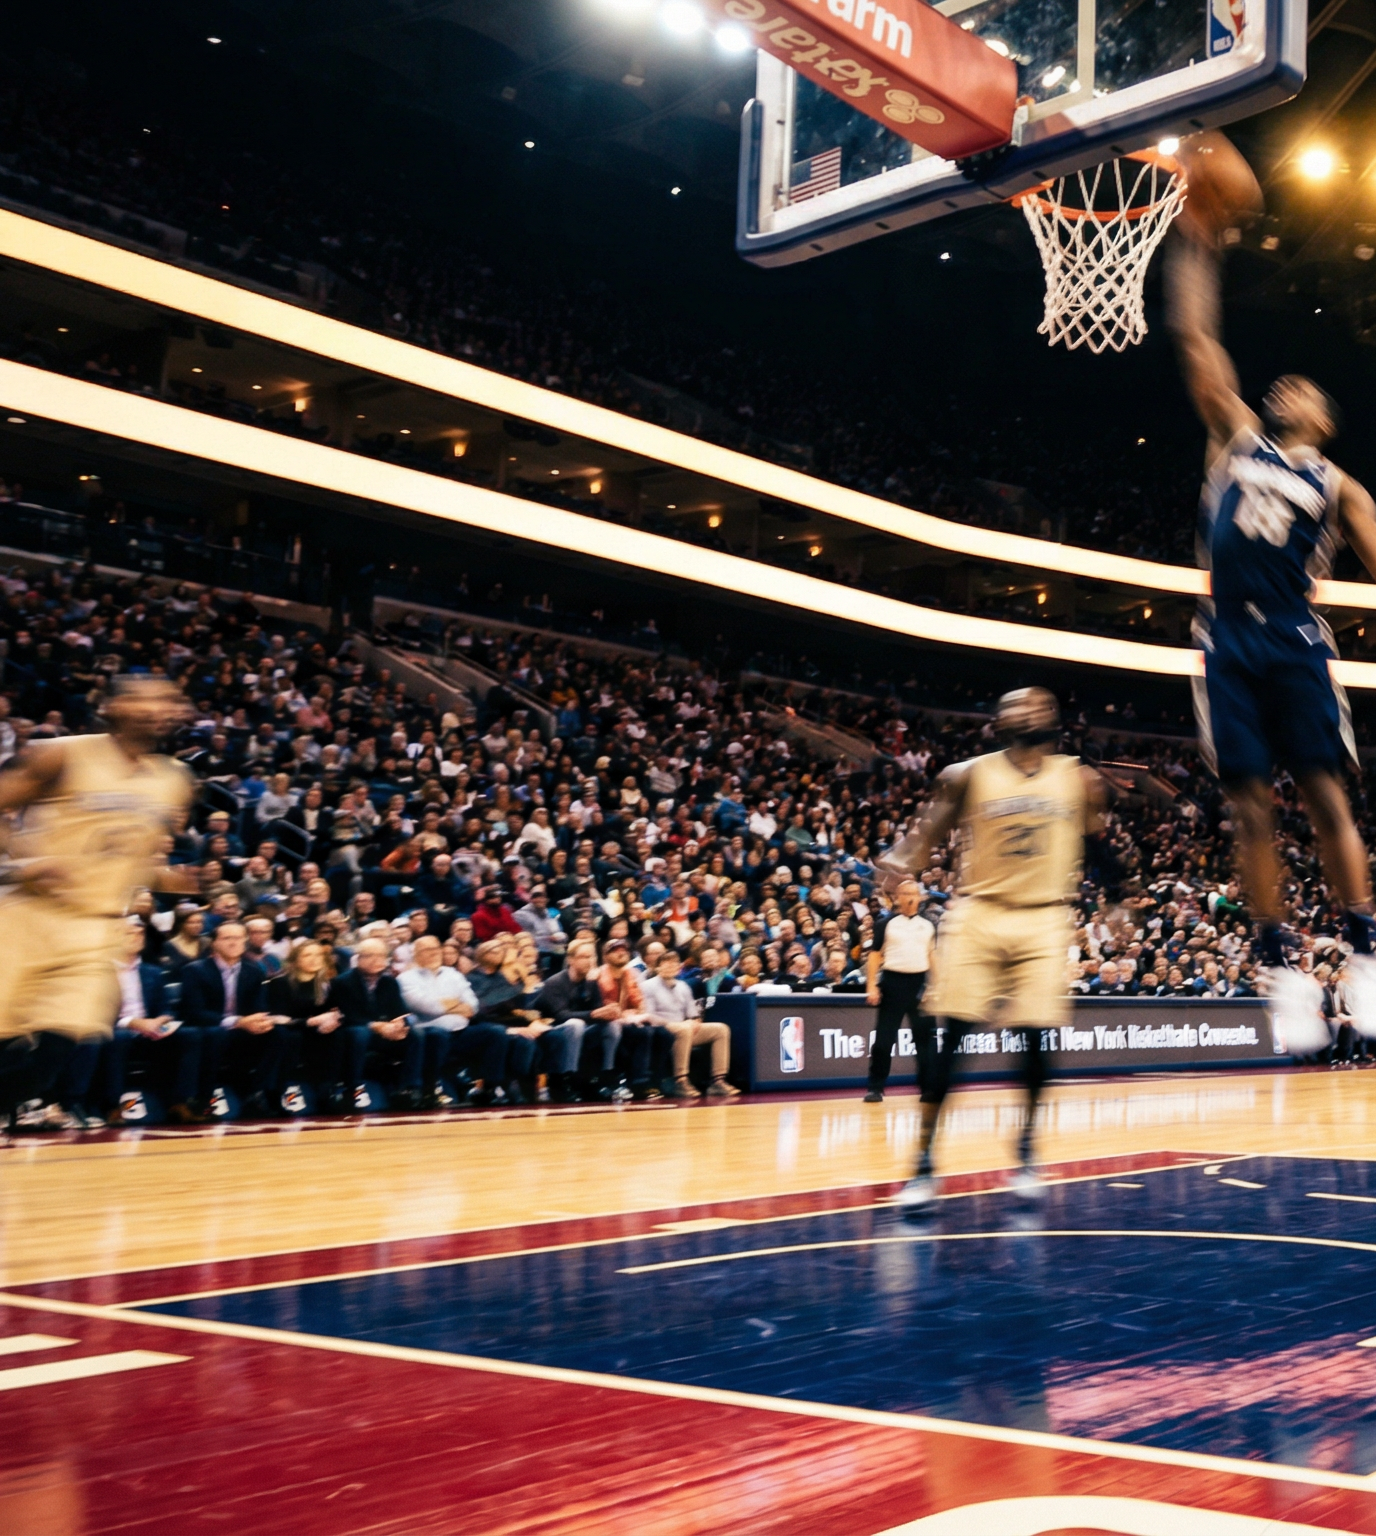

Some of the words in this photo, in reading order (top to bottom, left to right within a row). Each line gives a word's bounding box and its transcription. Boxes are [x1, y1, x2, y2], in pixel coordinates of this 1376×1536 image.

[806, 0, 913, 59] arm
[819, 1028, 866, 1060] The
[1060, 1026, 1094, 1051] New
[1093, 1025, 1127, 1050] York
